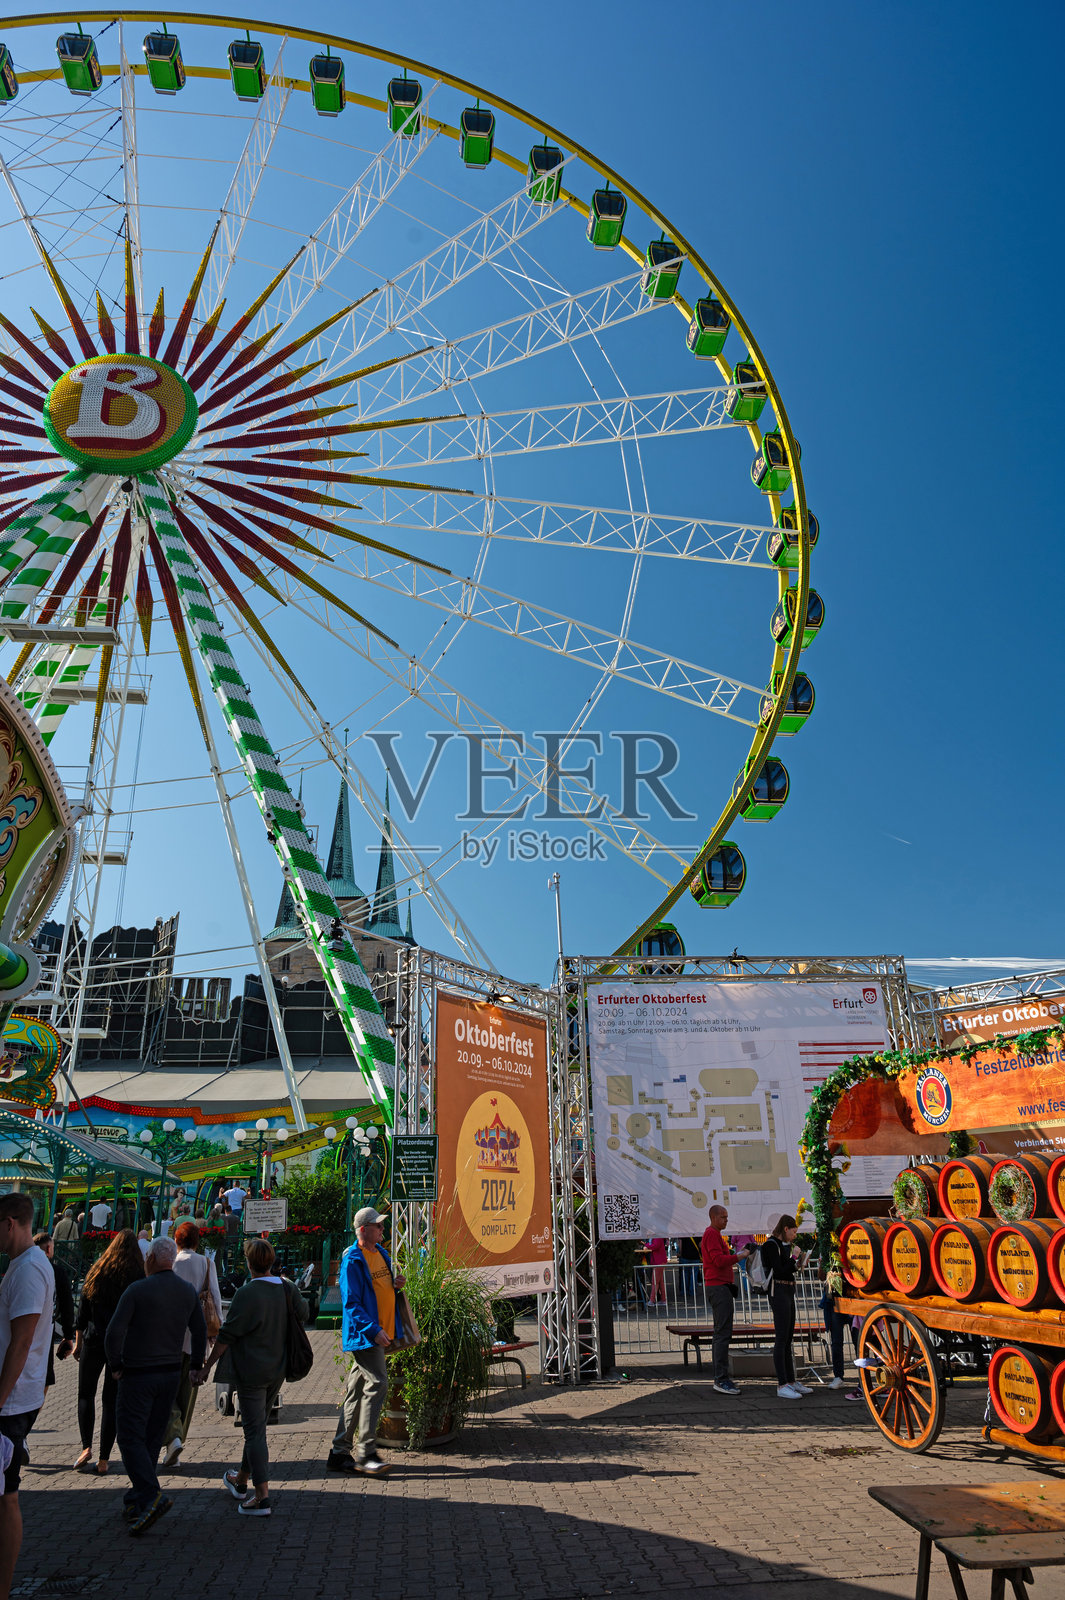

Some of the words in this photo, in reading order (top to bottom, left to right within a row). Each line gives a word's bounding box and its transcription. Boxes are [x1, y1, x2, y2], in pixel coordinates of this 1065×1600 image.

[66, 363, 163, 444] B
[598, 994, 640, 1004] Erfurter
[642, 994, 707, 1004] Oktoberfest
[832, 998, 864, 1008] Erfurt
[636, 1007, 688, 1017] 06.10.2024
[942, 1013, 999, 1032] Erfurter
[455, 1018, 534, 1058] Oktoberfest
[458, 1050, 484, 1068] 20.09.
[492, 1057, 532, 1078] 06.10.2024
[916, 1068, 948, 1092] PAULANER
[1014, 1138, 1054, 1148] Verbinden
[481, 1179, 516, 1211] 2024
[482, 1224, 516, 1236] DOMPLATZ
[944, 1257, 972, 1265] MÜNCHEN
[1002, 1267, 1034, 1276] MÜNCHEN
